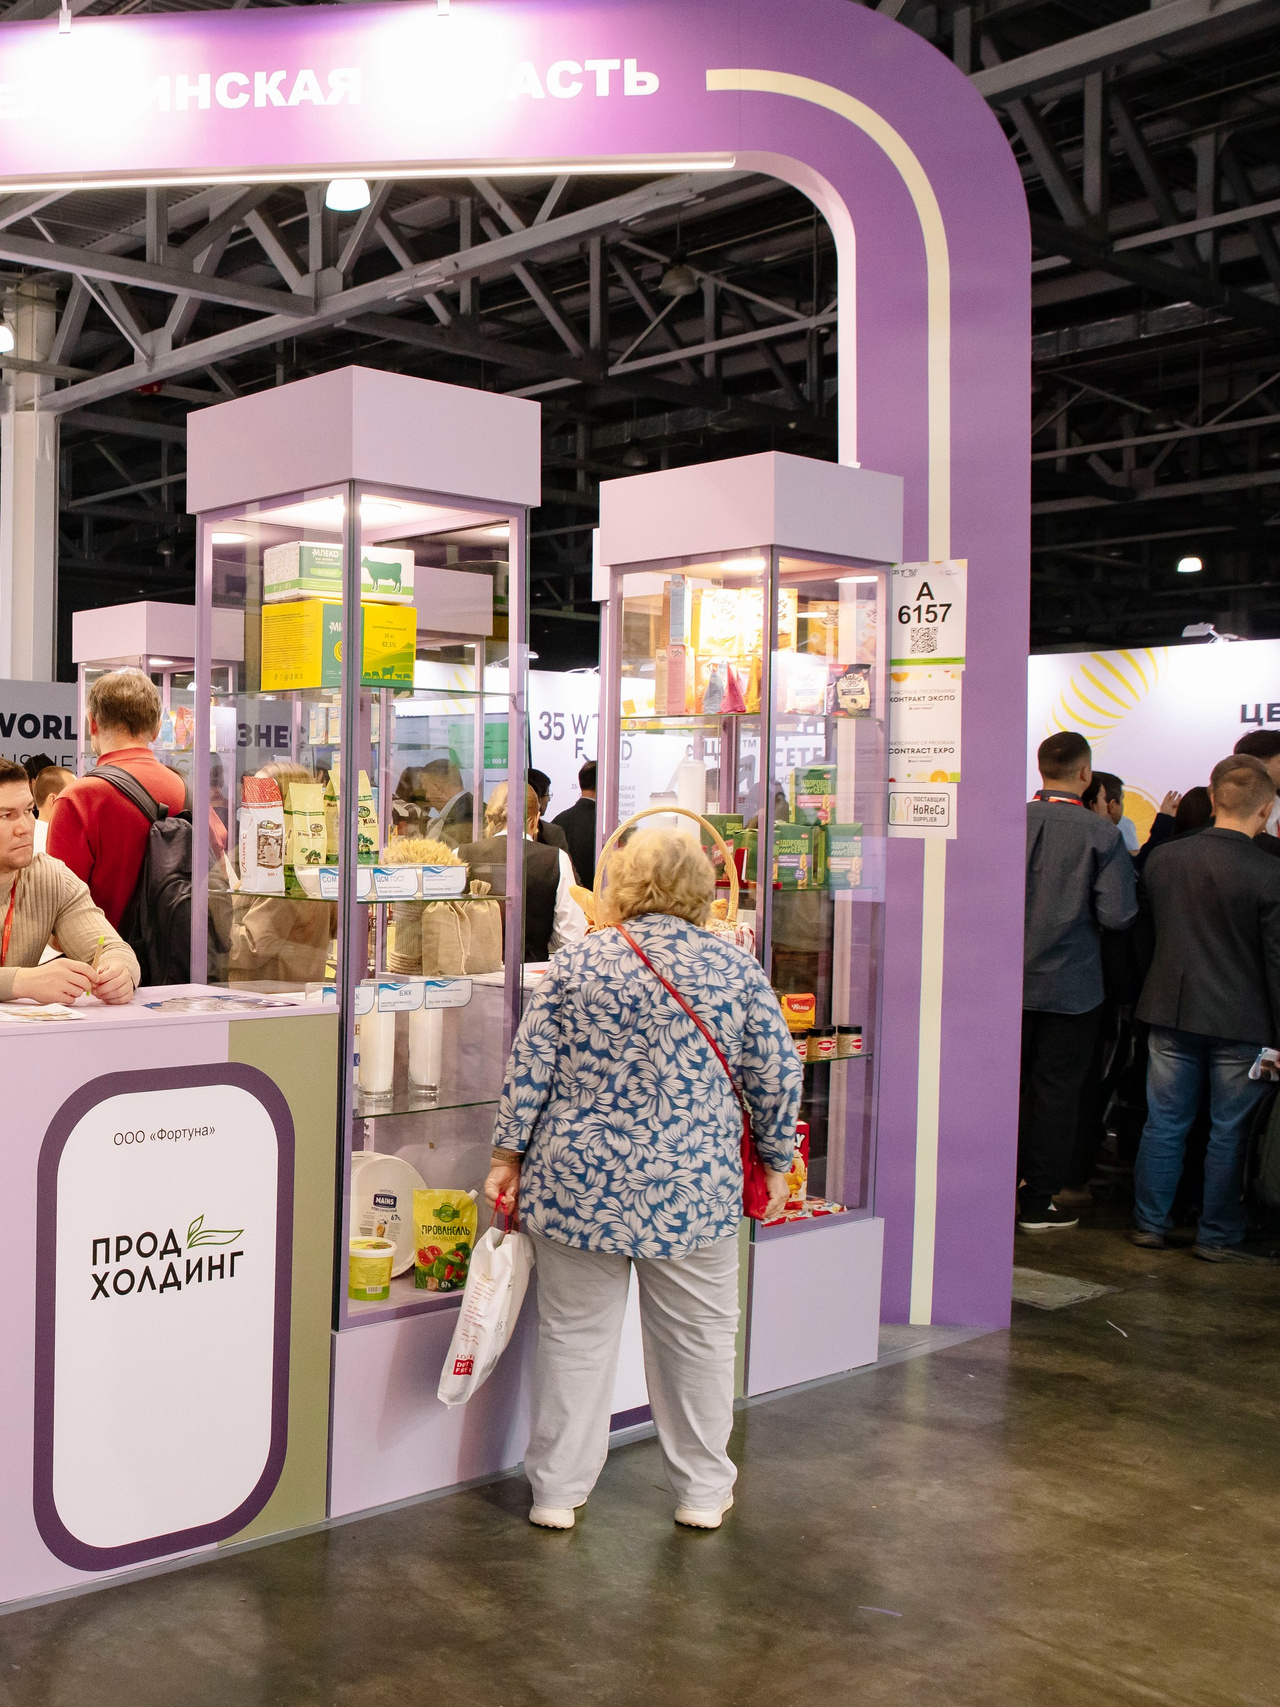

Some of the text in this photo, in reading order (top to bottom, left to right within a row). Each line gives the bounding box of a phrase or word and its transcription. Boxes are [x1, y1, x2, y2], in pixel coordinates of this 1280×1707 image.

[916, 581, 935, 601] A
[898, 603, 952, 624] 6157
[927, 694, 956, 702] ЭКСПО
[538, 711, 565, 741] 35
[888, 747, 932, 755] CONTRACT
[913, 804, 945, 815] HoReCa
[113, 1126, 215, 1146] ООО «Фортуна»
[375, 1197, 395, 1205] MAINS
[421, 1224, 471, 1236] ПРОВАНСАЛЬ
[92, 1228, 182, 1266] ПРОД
[90, 1250, 244, 1301] ХОЛДИНГ
